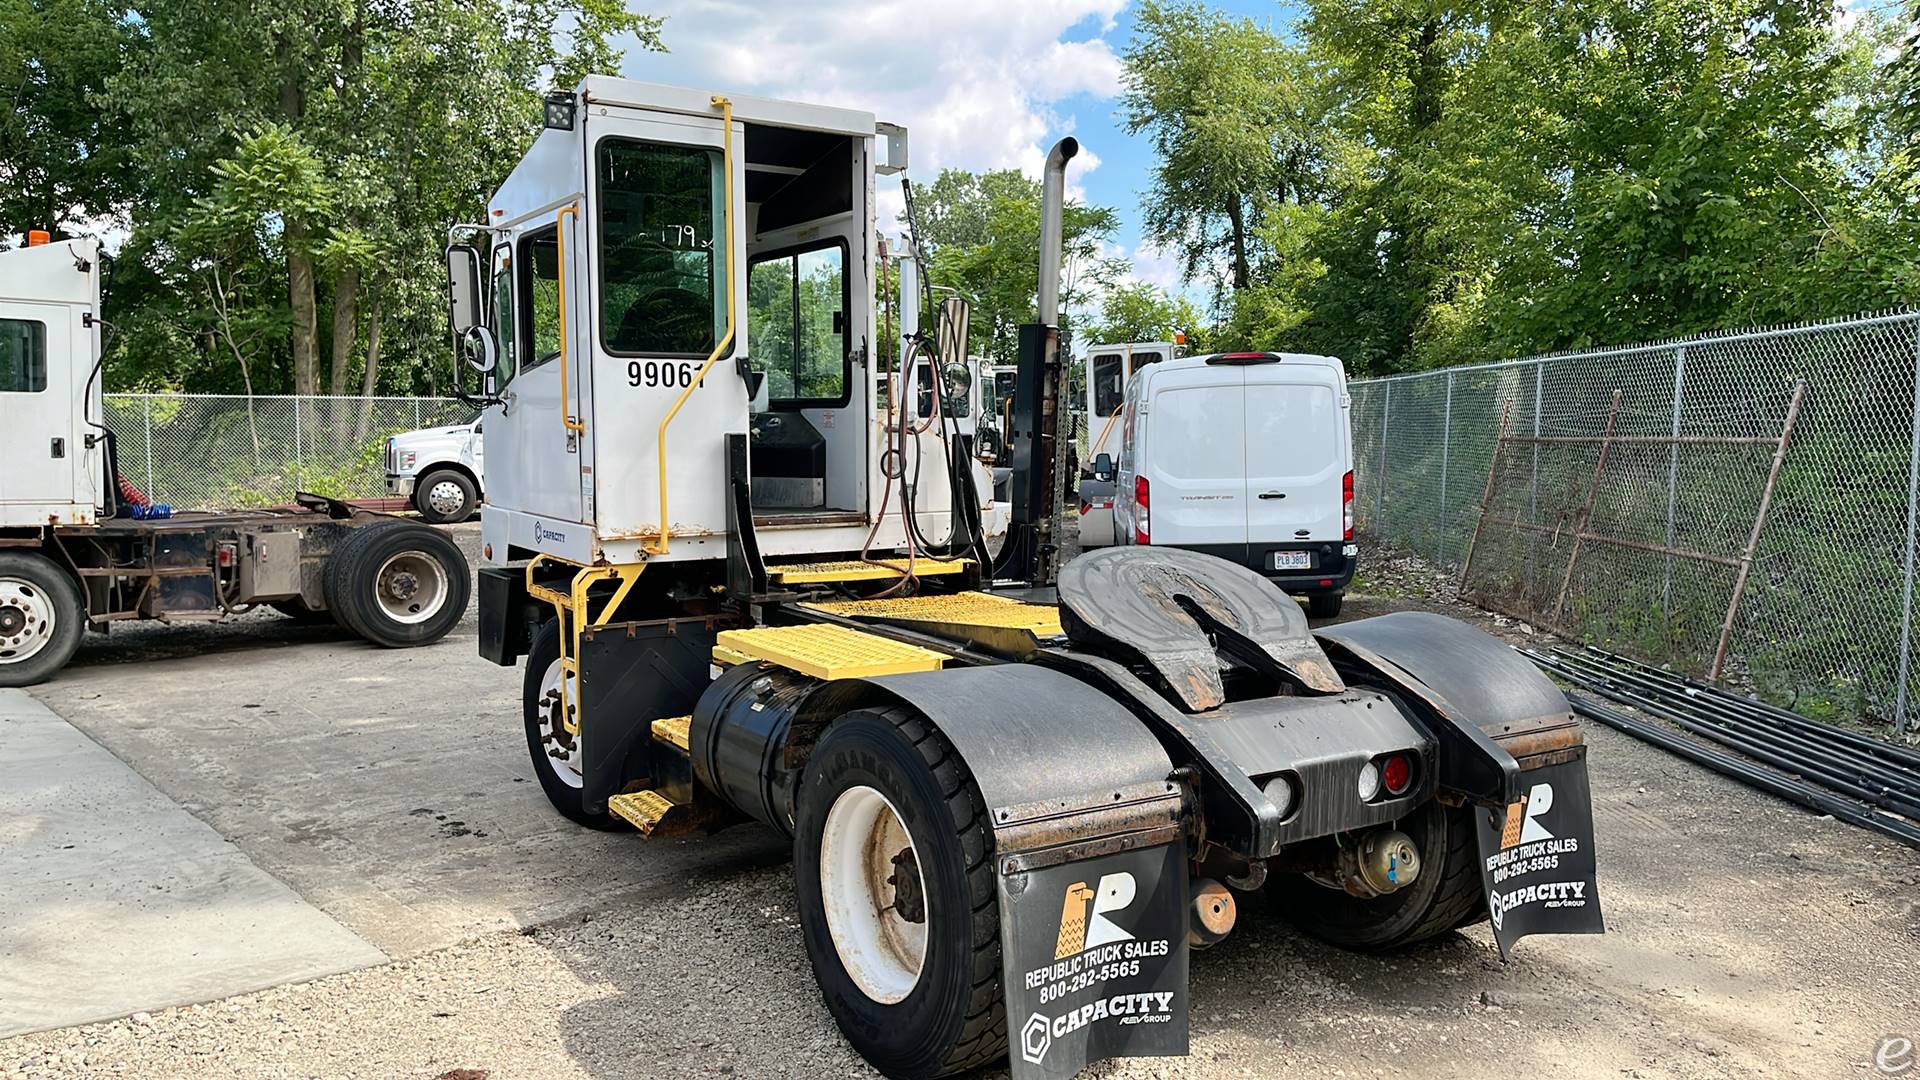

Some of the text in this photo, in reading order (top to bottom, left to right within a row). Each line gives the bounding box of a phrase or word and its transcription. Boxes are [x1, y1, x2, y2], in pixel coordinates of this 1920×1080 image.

[627, 361, 704, 388] 99061
[1277, 555, 1290, 565] PLB
[1486, 838, 1578, 872] REPUBLIC TRUCK SALES
[1493, 855, 1559, 884] 800-292-5565
[1501, 881, 1585, 913] CAPACITY
[1025, 940, 1169, 990] REPUBLIC TRUCK SALES
[1039, 960, 1140, 1004] 800-292-5565
[1052, 992, 1174, 1038] CAPACITY
